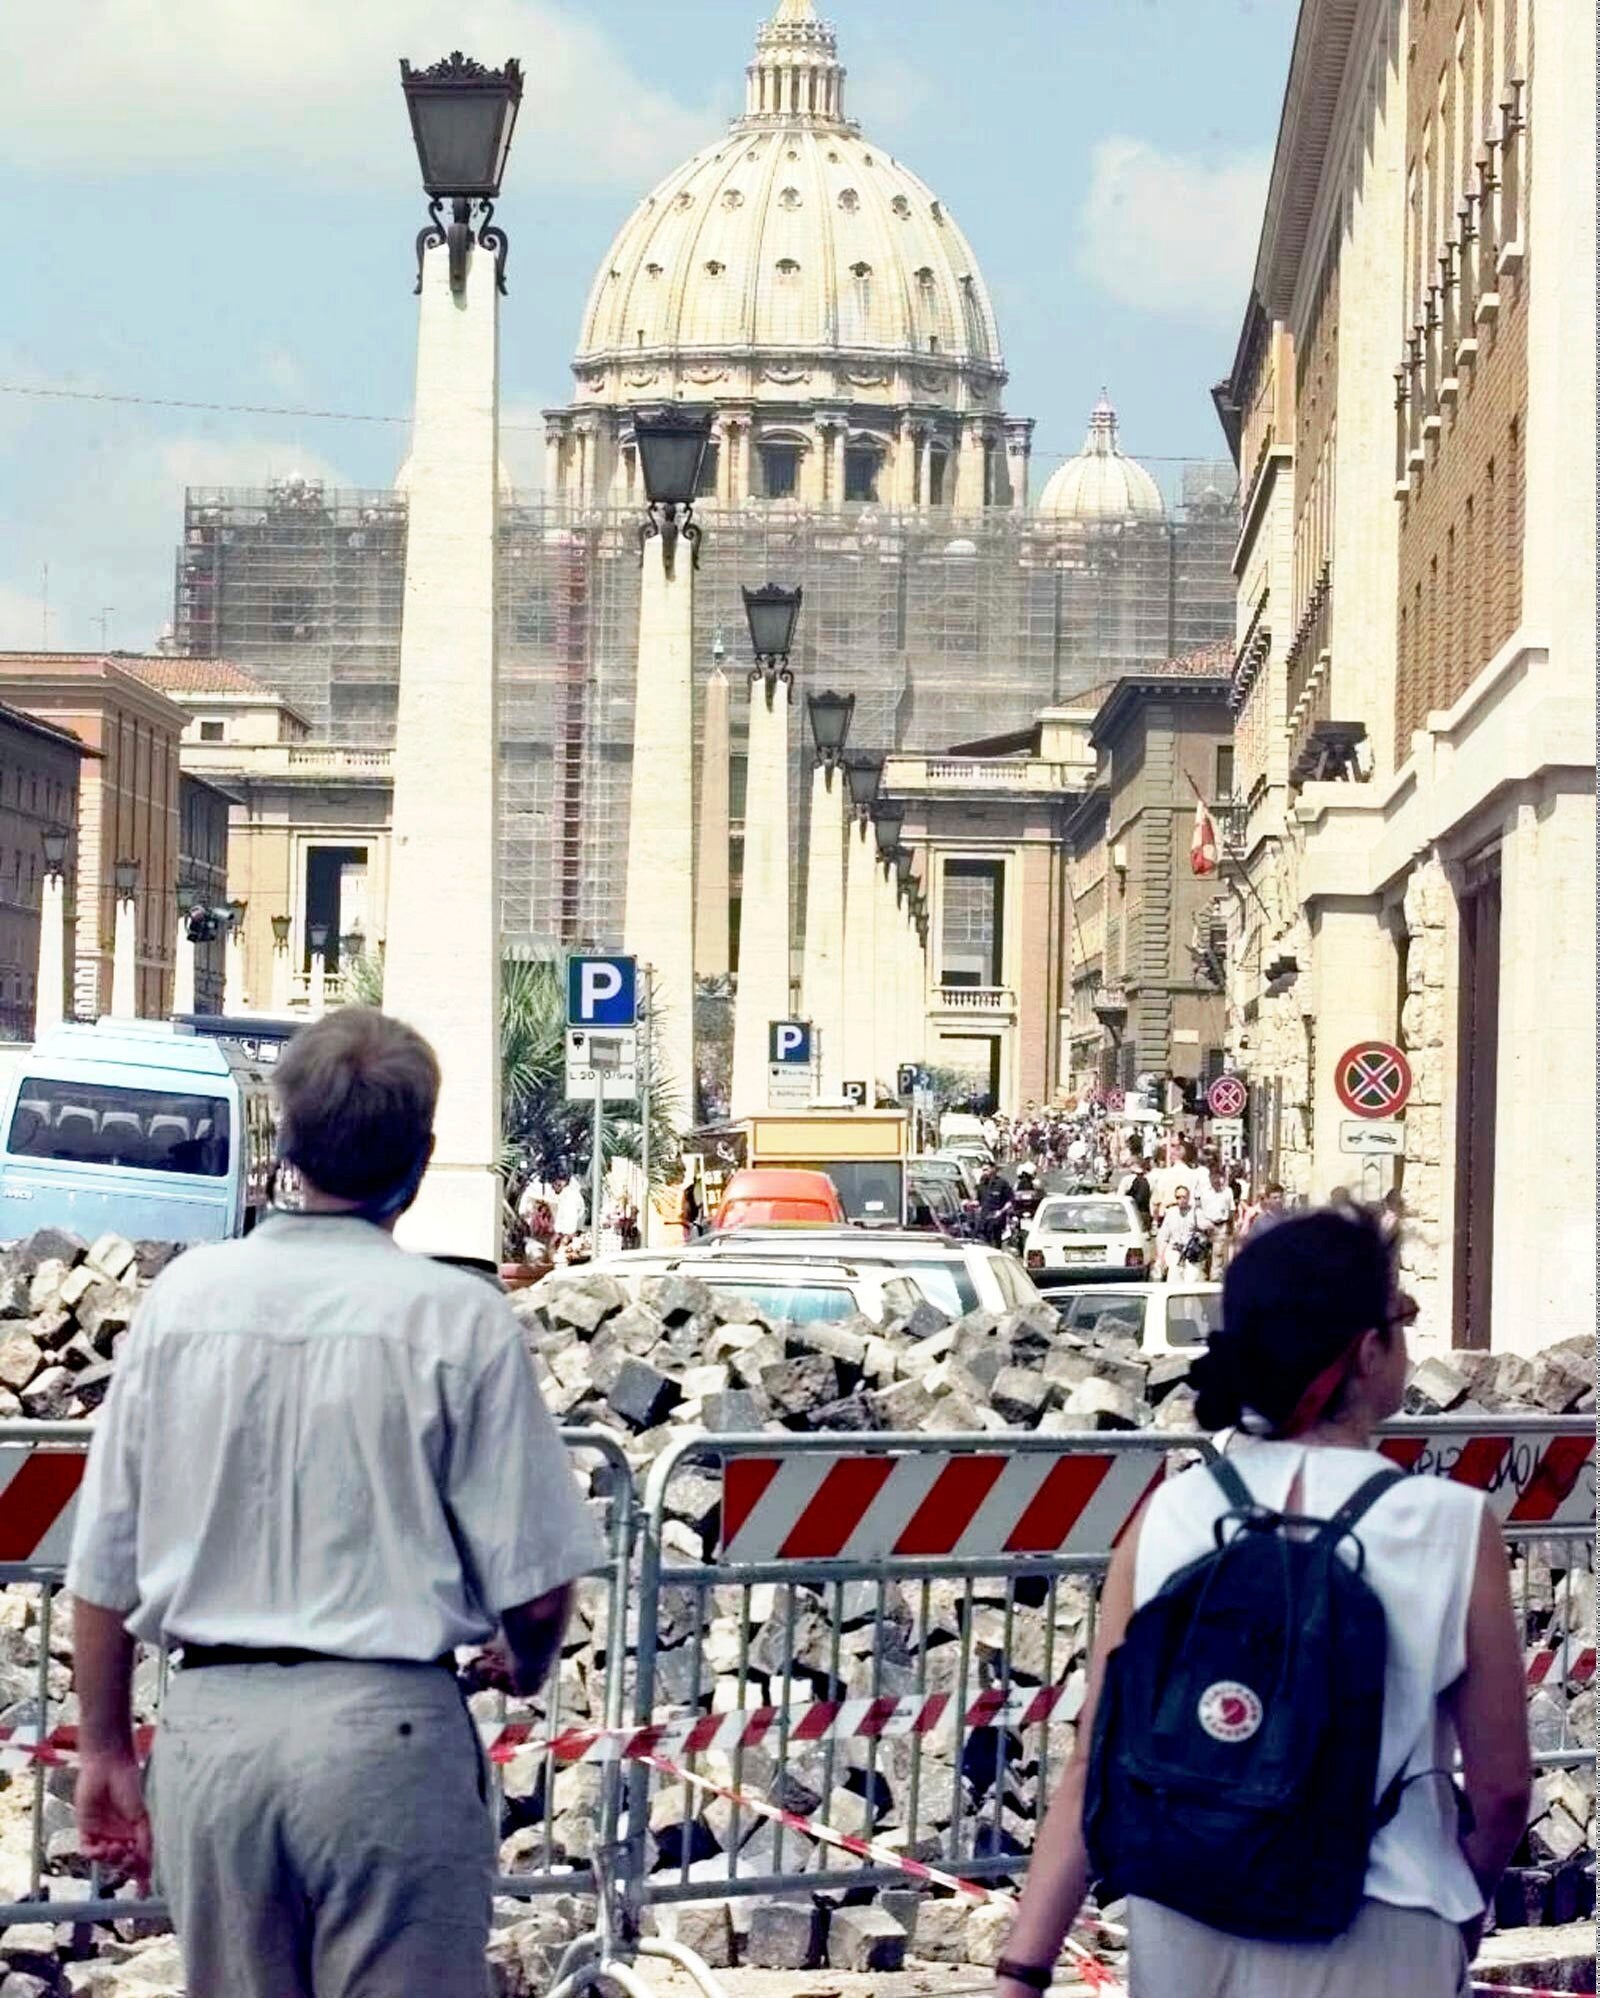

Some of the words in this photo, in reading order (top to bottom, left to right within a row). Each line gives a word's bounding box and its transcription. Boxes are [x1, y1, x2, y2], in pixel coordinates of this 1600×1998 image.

[581, 962, 622, 1018] P
[777, 1026, 803, 1059] P
[847, 1083, 862, 1102] P
[901, 1073, 911, 1093] P
